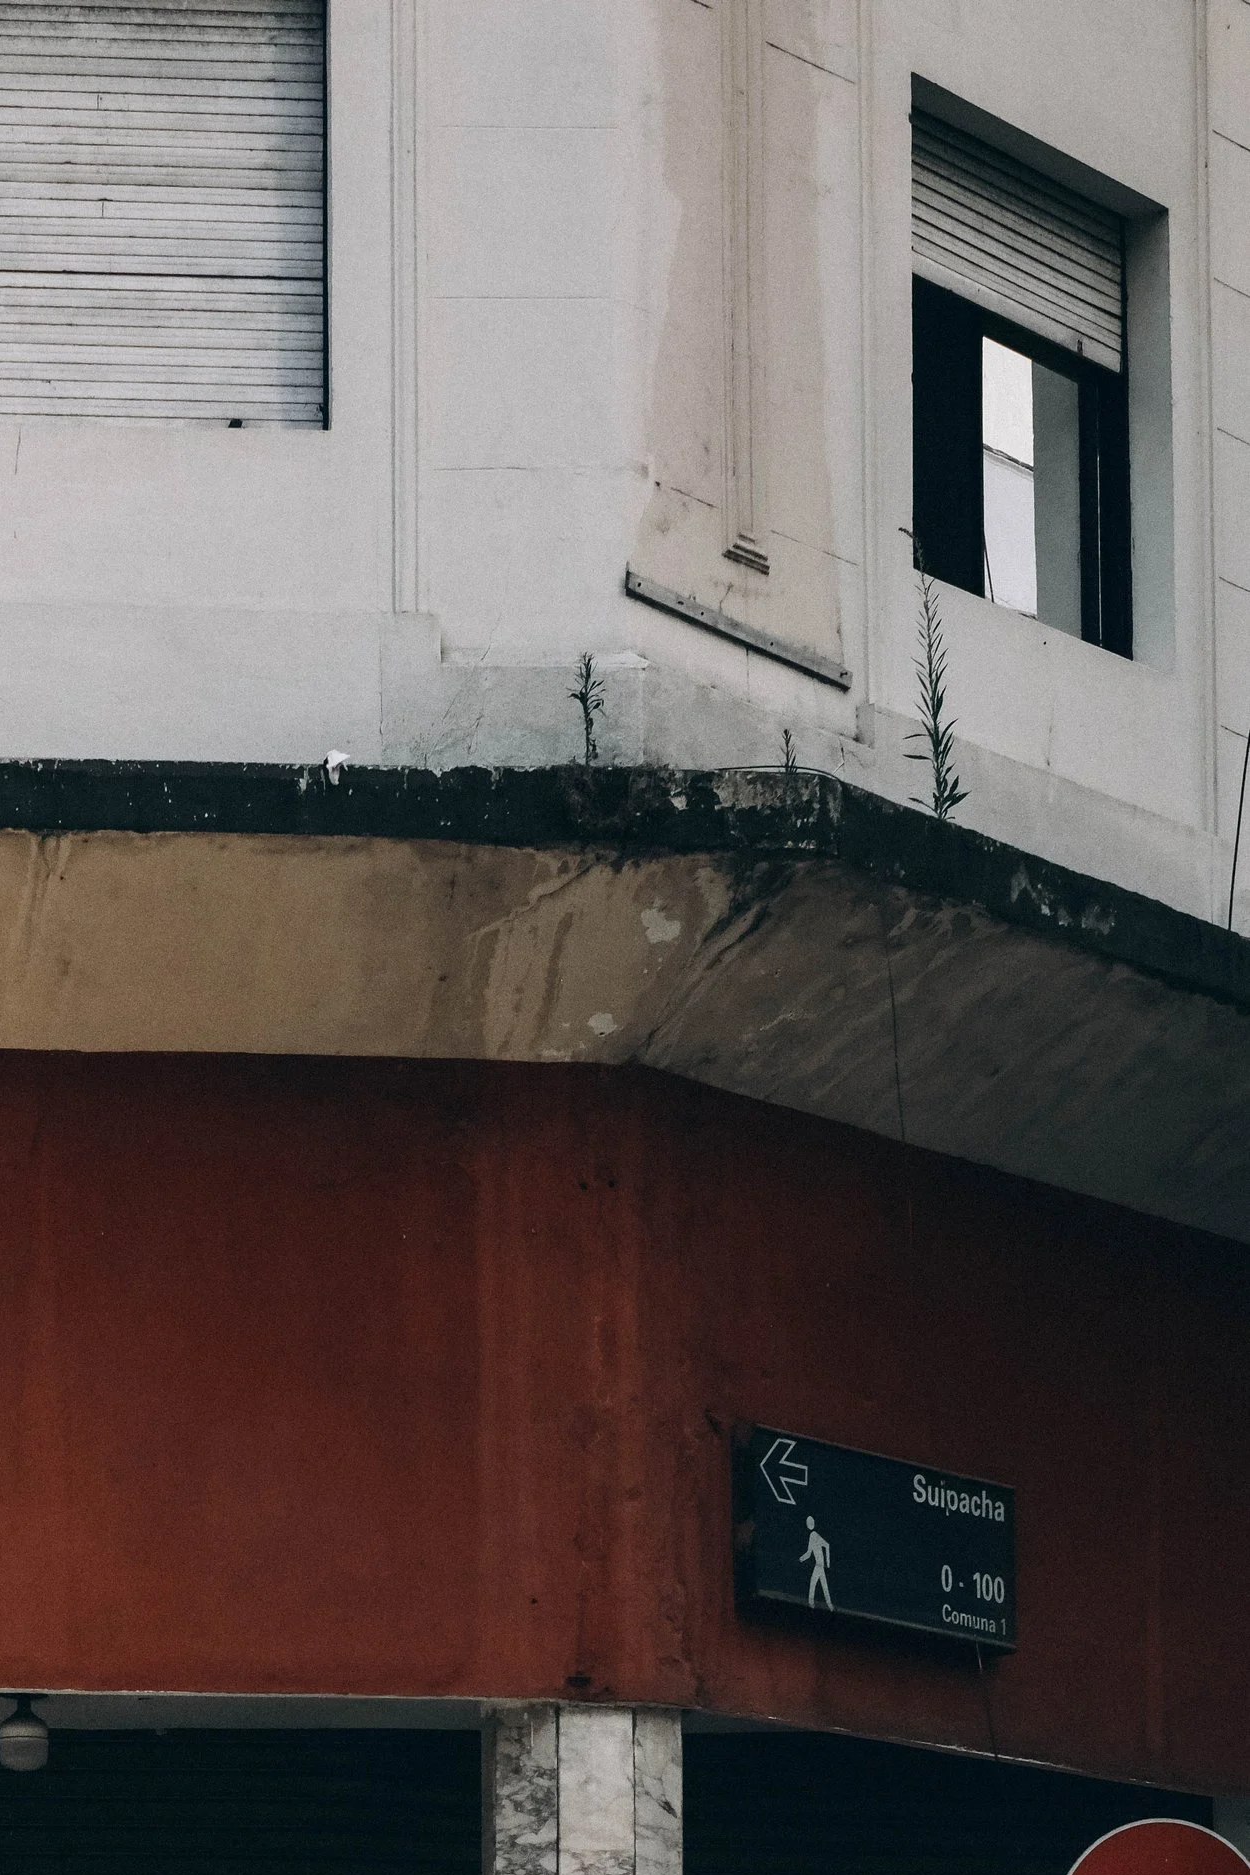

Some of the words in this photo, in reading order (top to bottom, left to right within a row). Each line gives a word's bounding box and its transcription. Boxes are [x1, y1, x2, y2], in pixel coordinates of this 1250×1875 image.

[912, 1474, 1006, 1523] Suipacha
[940, 1564, 953, 1594] 0
[972, 1571, 1005, 1605] 100
[941, 1603, 997, 1633] Comuna
[999, 1617, 1007, 1636] 1
